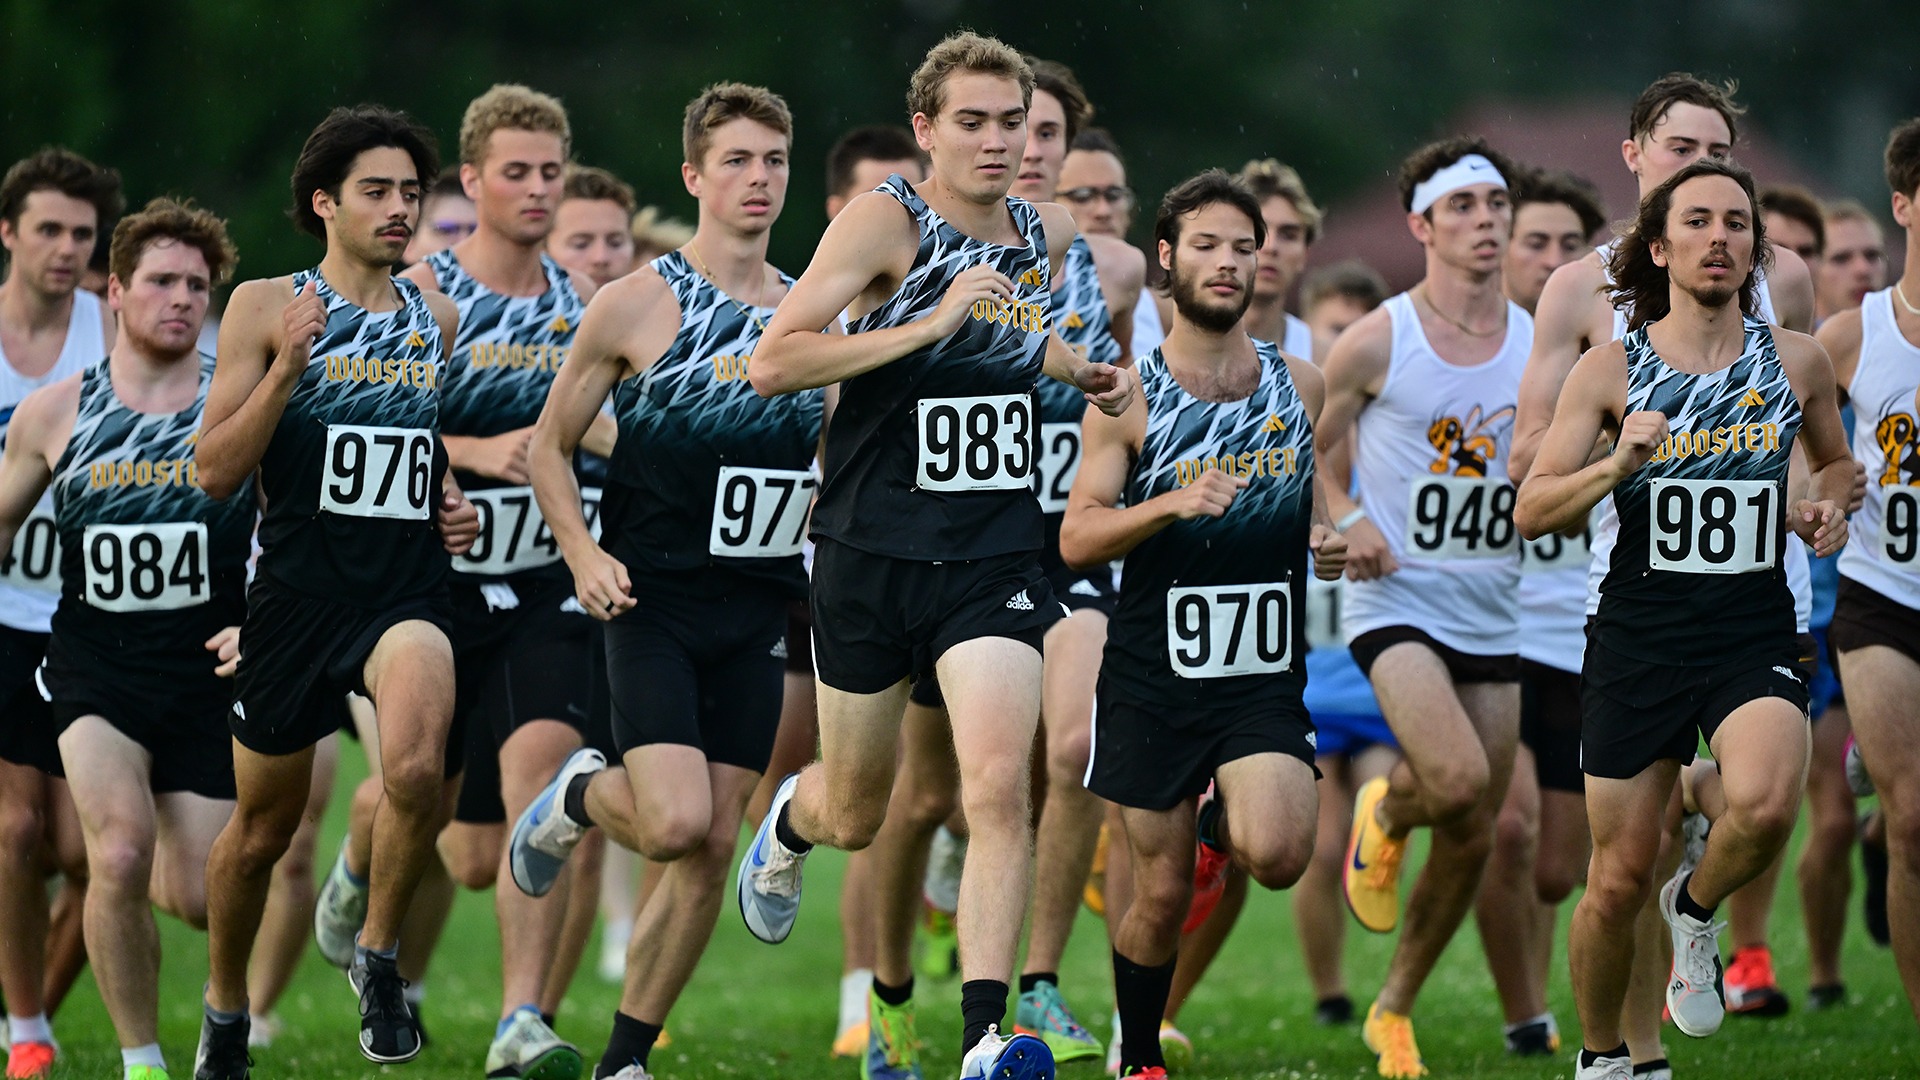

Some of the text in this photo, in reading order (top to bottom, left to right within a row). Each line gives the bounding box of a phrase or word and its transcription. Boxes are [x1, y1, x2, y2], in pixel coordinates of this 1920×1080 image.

[972, 297, 1044, 334] OOSTER
[325, 355, 436, 390] WOOSTER
[470, 344, 569, 373] WOOSTE
[91, 458, 199, 489] WOOSTE
[329, 432, 430, 510] 976
[926, 400, 1030, 482] 983
[1414, 484, 1518, 550] 948
[1656, 485, 1771, 564] 981
[91, 531, 205, 601] 984
[1175, 589, 1288, 668] 970
